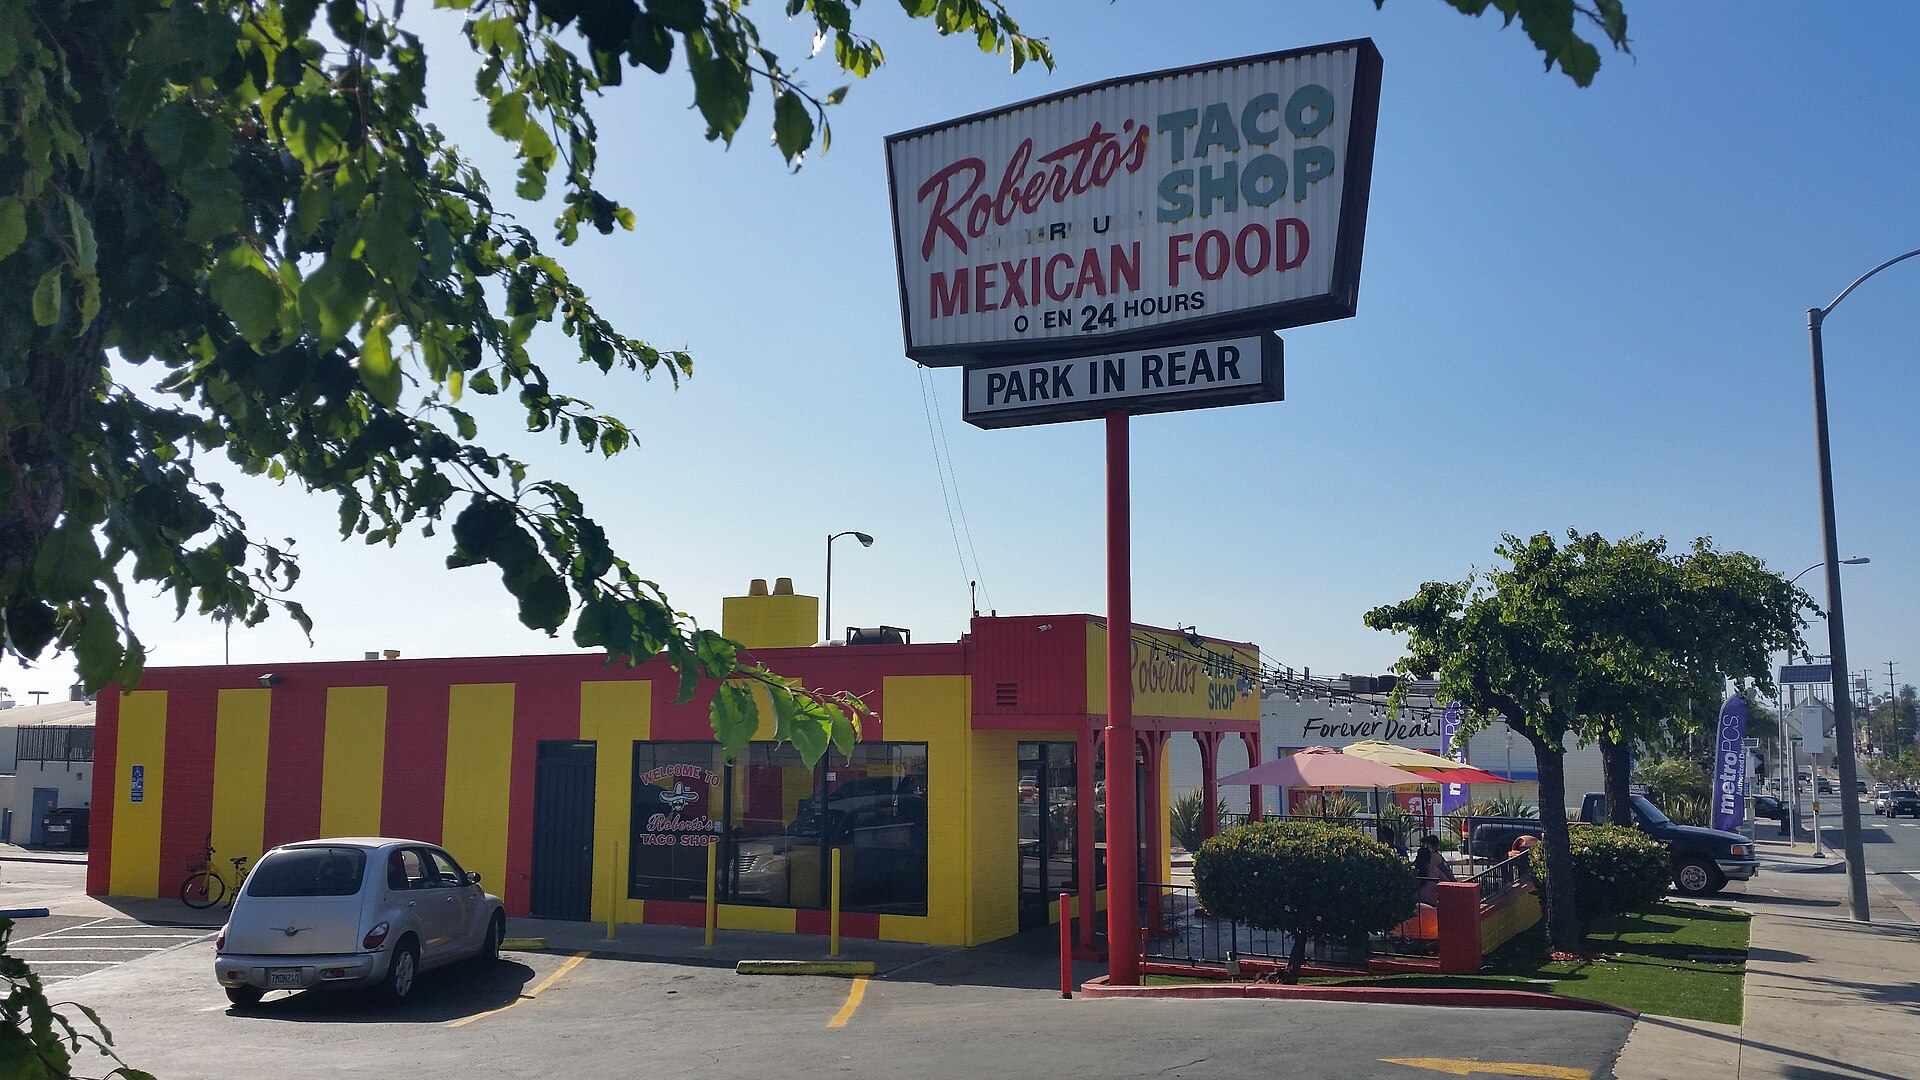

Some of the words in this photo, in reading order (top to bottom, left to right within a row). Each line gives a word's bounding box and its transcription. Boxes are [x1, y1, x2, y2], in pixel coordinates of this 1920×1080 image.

[917, 119, 1149, 262] Roberto's
[1157, 84, 1334, 164] TACO
[1157, 145, 1335, 223] SHOP
[931, 241, 1141, 319] MEXICAN
[1168, 217, 1310, 287] FOOD
[1081, 303, 1117, 331] 24
[1124, 291, 1205, 318] HOURS
[987, 363, 1074, 405] PARK
[1089, 358, 1125, 394] IN
[1142, 345, 1241, 389] REAR
[1208, 683, 1236, 711] SHOP
[1302, 717, 1382, 738] Forever
[640, 764, 701, 786] WELCOME
[704, 770, 720, 788] TO
[1720, 714, 1740, 815] metroPCS
[1736, 760, 1744, 795] Authorized
[640, 833, 677, 846] TACO
[680, 835, 720, 847] SHOP
[646, 813, 713, 831] Roberto's
